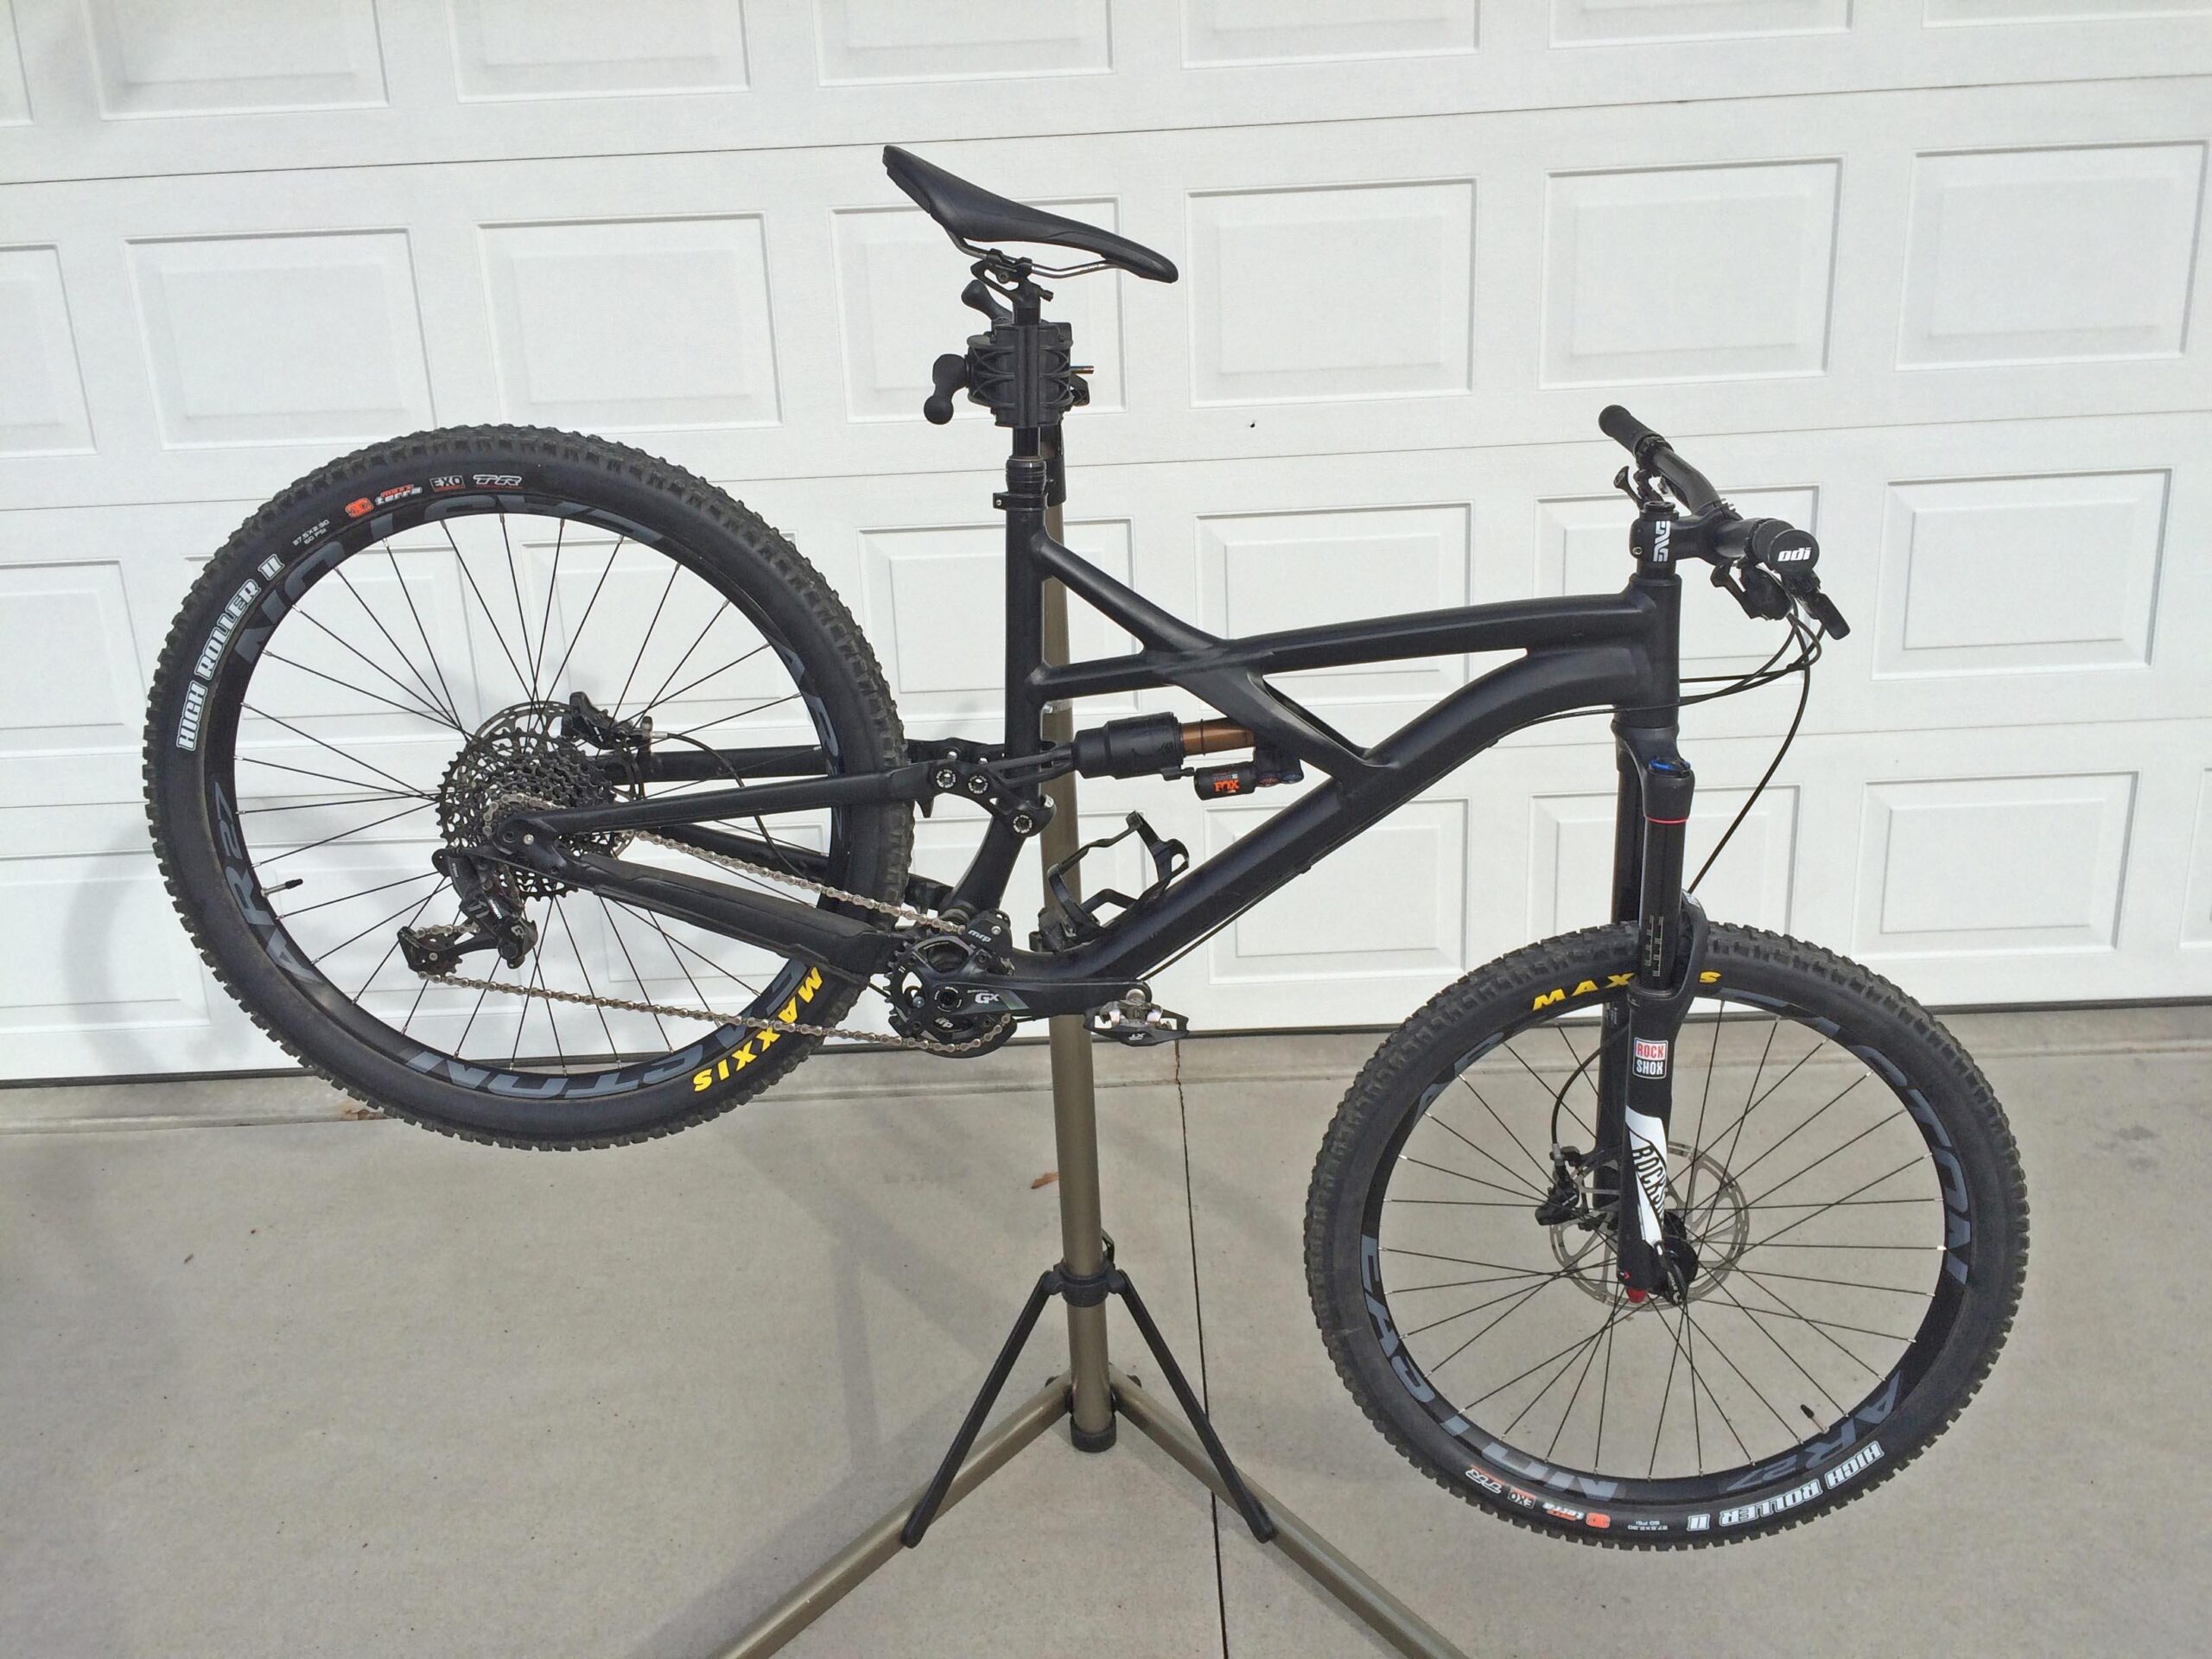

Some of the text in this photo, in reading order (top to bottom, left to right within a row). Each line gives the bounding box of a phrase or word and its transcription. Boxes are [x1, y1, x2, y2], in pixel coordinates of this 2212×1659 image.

[432, 476, 461, 487] EXO
[1777, 546, 1812, 563] odi
[176, 553, 285, 751] HIGH ROLLER II
[1214, 780, 1239, 792] FOX
[968, 930, 991, 943] mrp
[976, 993, 1000, 1004] GX
[1532, 971, 1722, 1011] MAXS
[693, 966, 823, 1092] MAXXIS
[1637, 1043, 1664, 1058] ROCK
[1636, 1060, 1663, 1076] SHOX
[1687, 1440, 1885, 1531] HIGH ROLLER II
[1510, 1491, 1534, 1507] EXO
